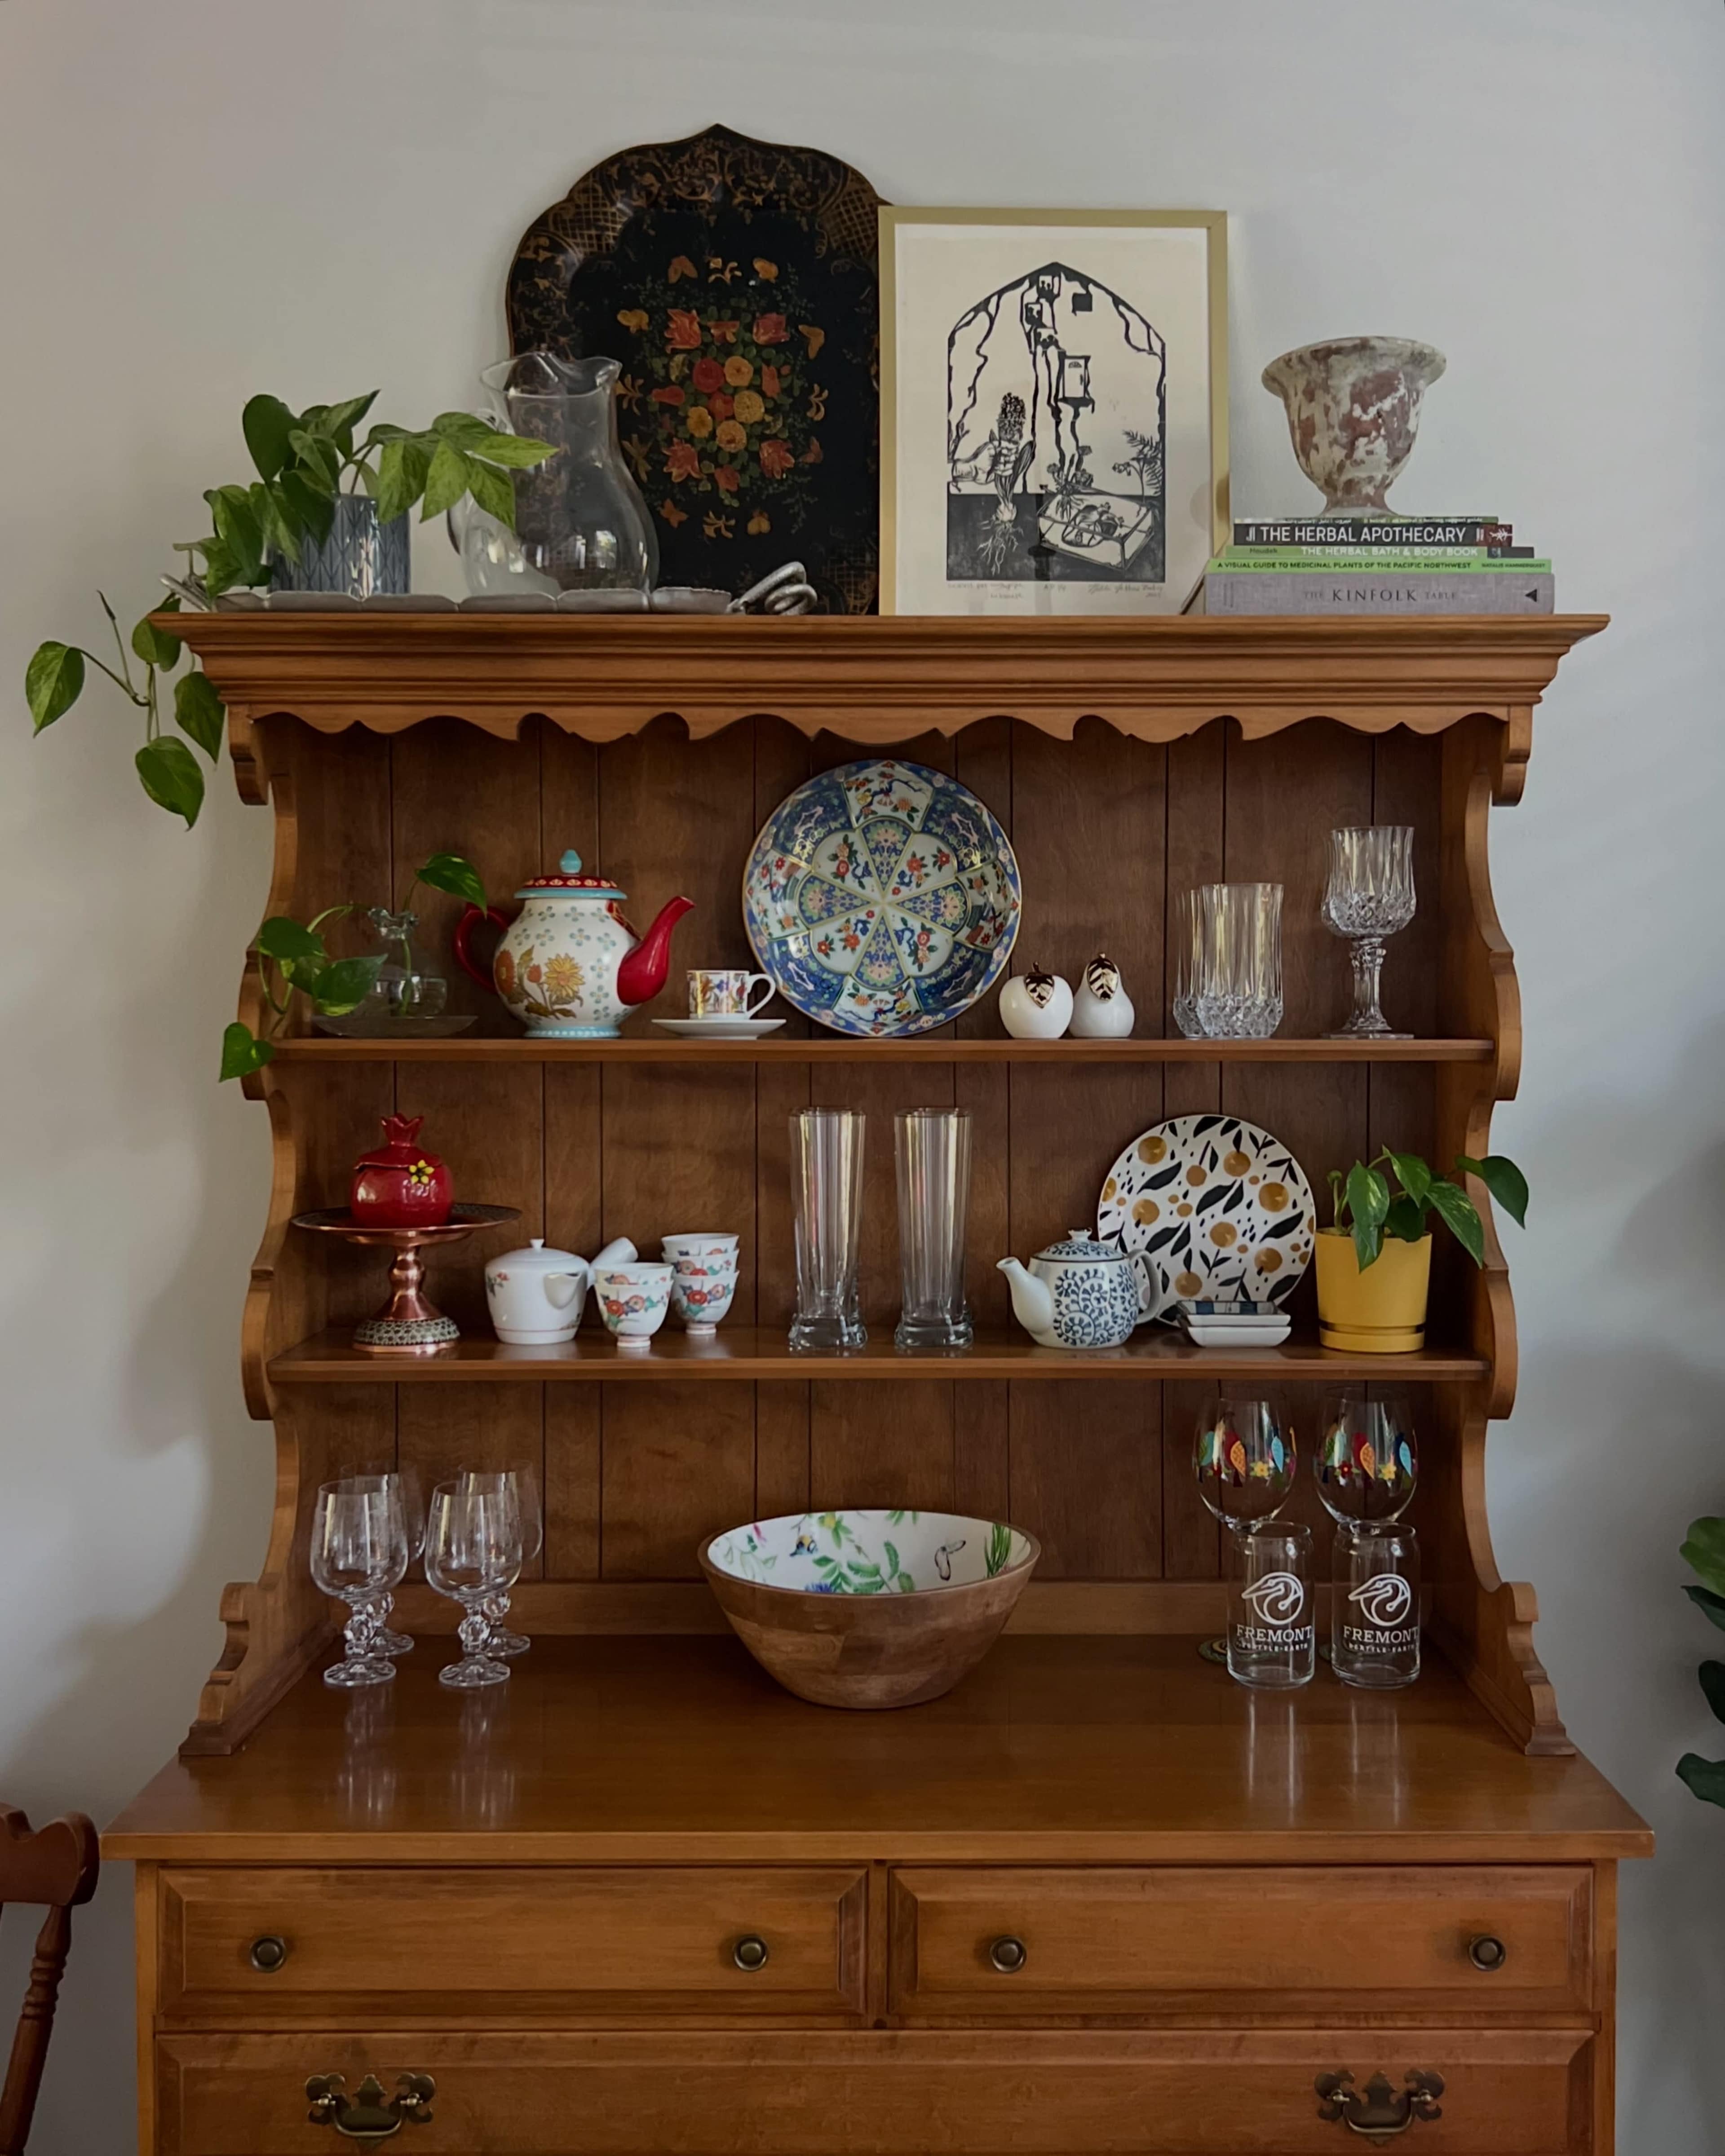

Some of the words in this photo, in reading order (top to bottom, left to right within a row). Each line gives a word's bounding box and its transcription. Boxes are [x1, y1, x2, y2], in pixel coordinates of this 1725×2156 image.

[1260, 527, 1290, 542] THE
[1295, 527, 1357, 542] HERBAL
[1360, 527, 1466, 543] APOTHECARY
[1301, 547, 1322, 556] THE
[1326, 547, 1368, 556] HERBAL
[1372, 547, 1399, 556] BATH
[1403, 547, 1411, 556] &
[1414, 547, 1442, 557] BODY
[1447, 547, 1477, 557] BOOK
[1332, 589, 1416, 601] KINFOLK
[1425, 591, 1456, 600] TABLE
[1237, 1624, 1313, 1642] FREMONT
[1343, 1625, 1419, 1644] FREMONT
